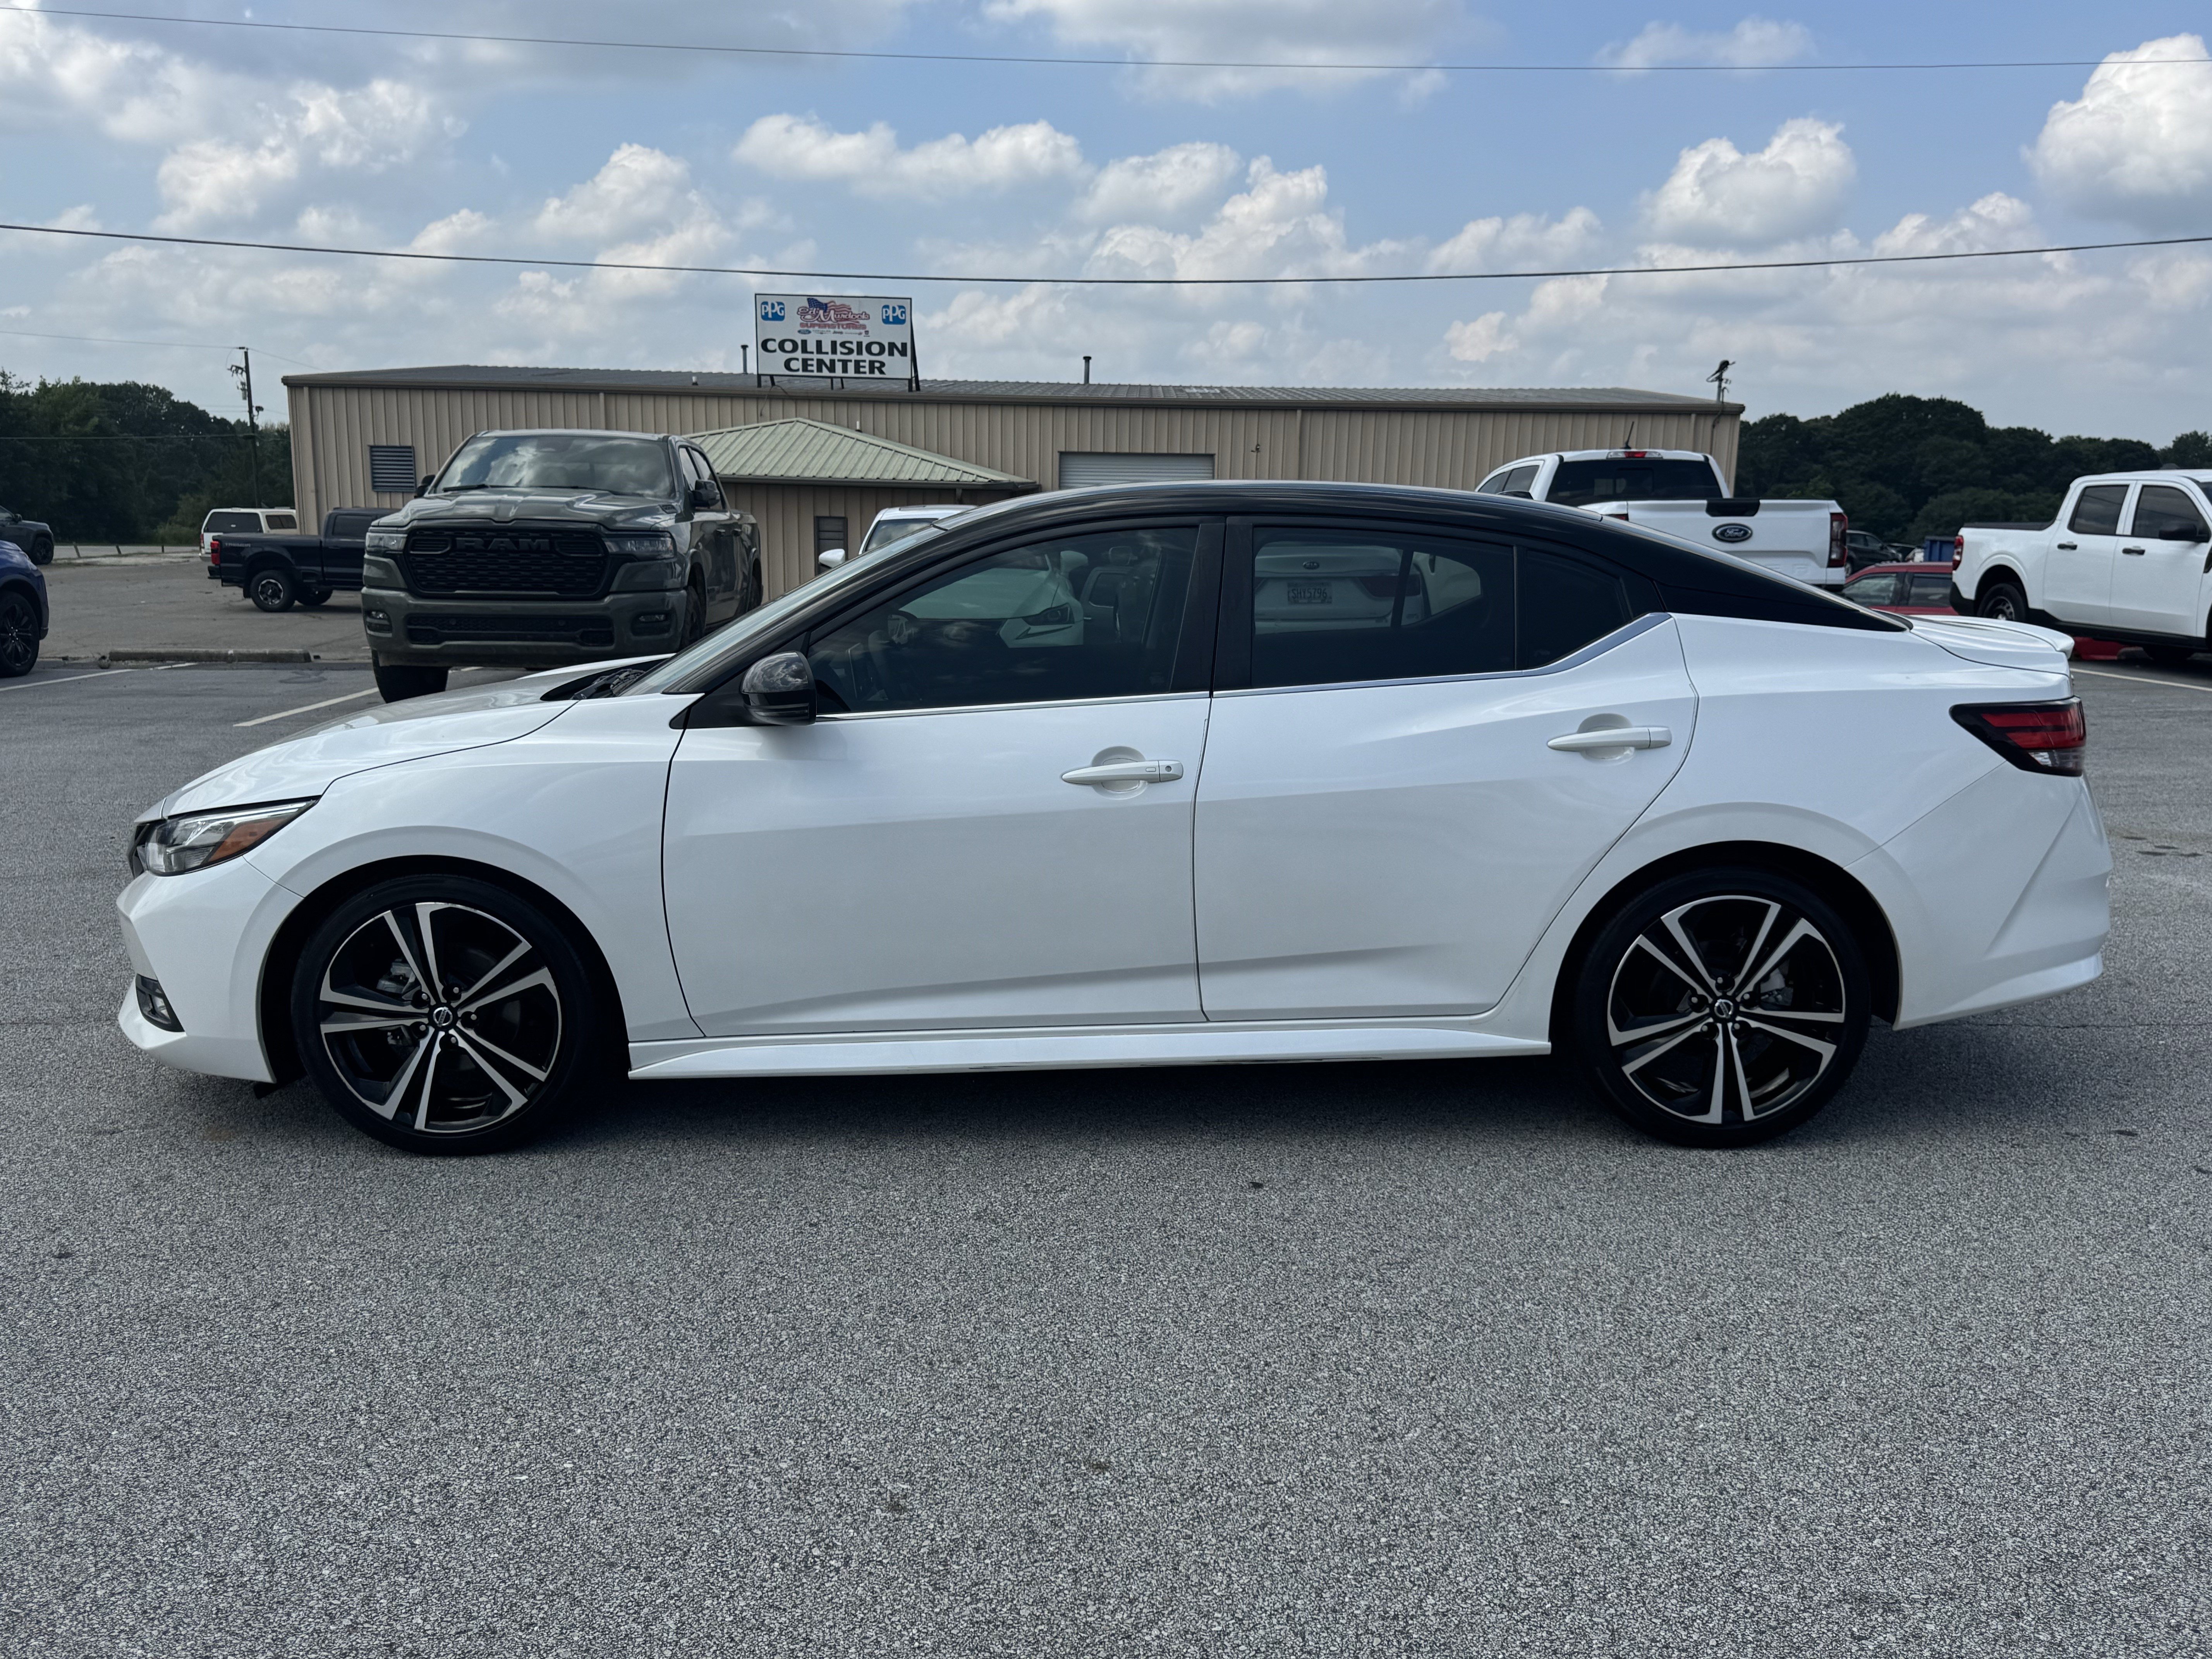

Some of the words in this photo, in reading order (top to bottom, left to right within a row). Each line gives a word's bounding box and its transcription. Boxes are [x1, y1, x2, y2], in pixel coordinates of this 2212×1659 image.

[761, 301, 784, 318] PPG
[883, 304, 905, 321] PPG
[761, 338, 907, 357] COLLISION
[784, 357, 886, 375] CENTER
[456, 537, 550, 550] RAM
